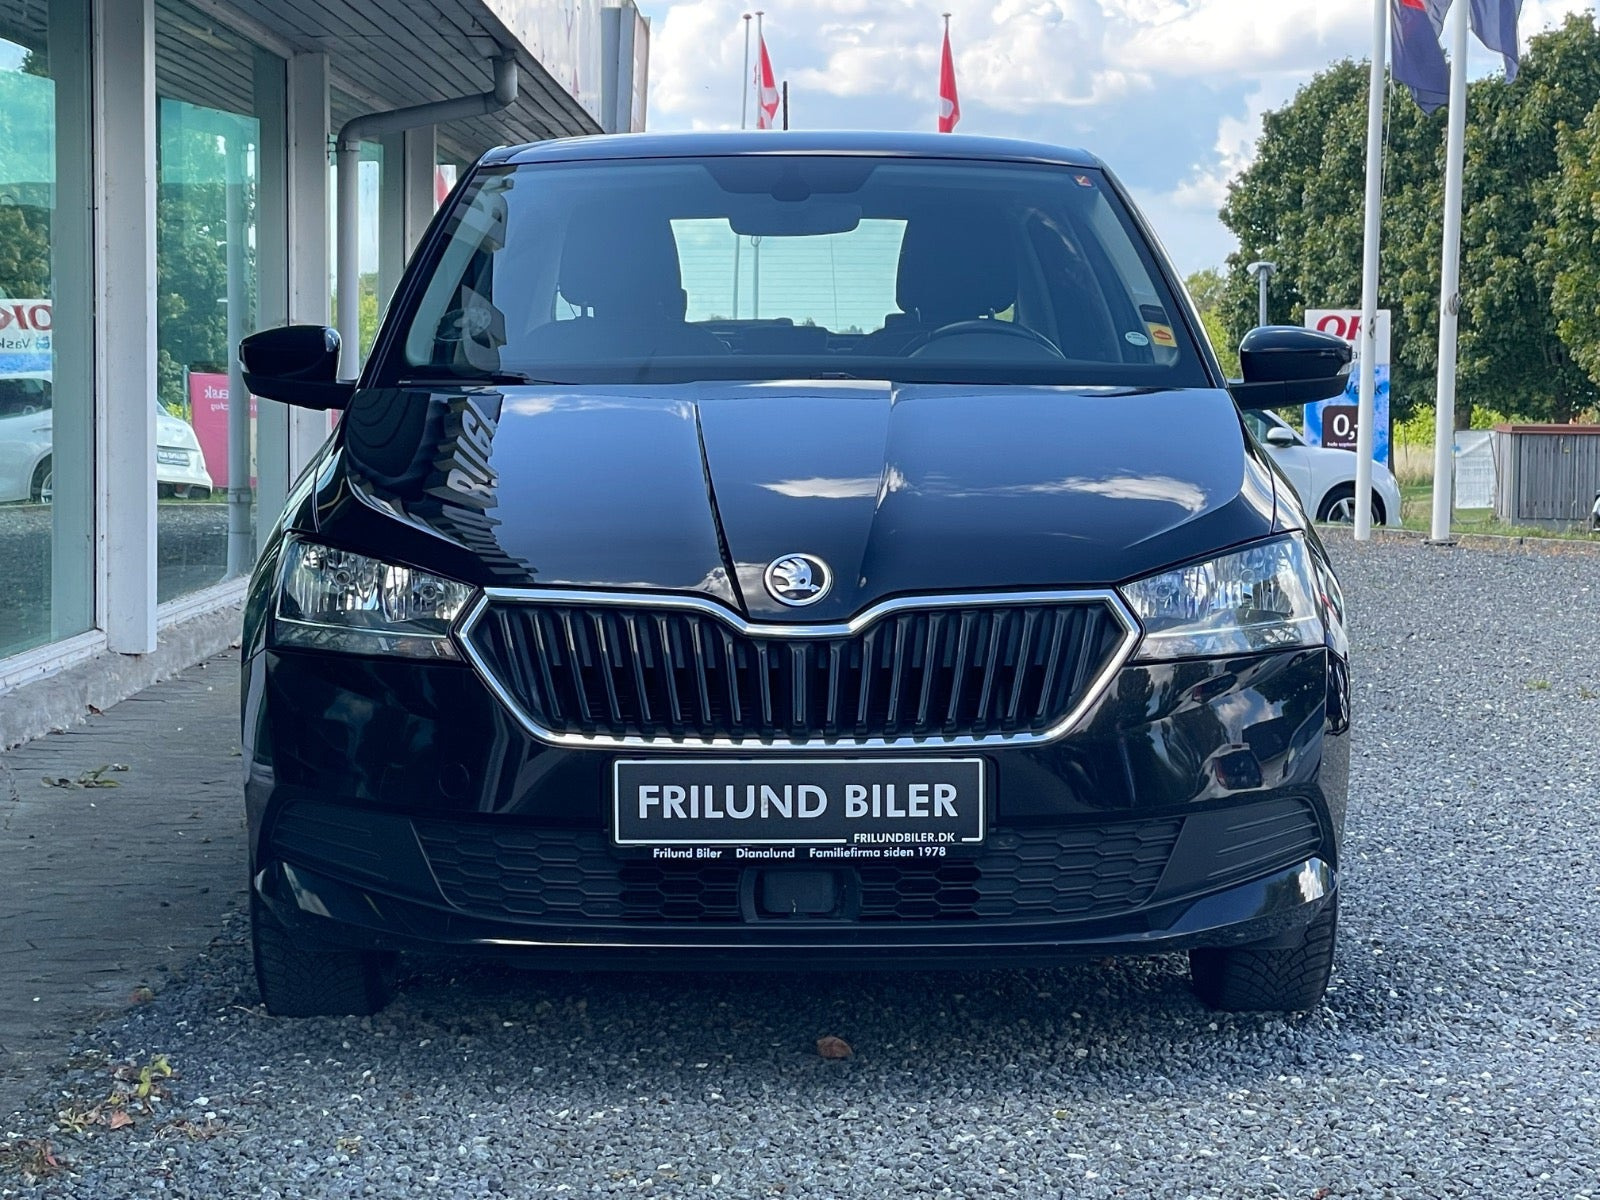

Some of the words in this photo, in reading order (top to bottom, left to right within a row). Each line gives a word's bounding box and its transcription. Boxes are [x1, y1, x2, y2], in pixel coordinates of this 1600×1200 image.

[638, 784, 828, 819] FRILUND
[845, 783, 959, 818] BILER
[853, 832, 955, 843] FRILUNDBILER.DK
[653, 848, 693, 859] Frilund
[696, 848, 723, 859] Biler
[736, 848, 796, 859] Dianalund
[809, 847, 881, 858] Familiefirma
[883, 847, 914, 857] siden
[918, 846, 946, 857] 1978
